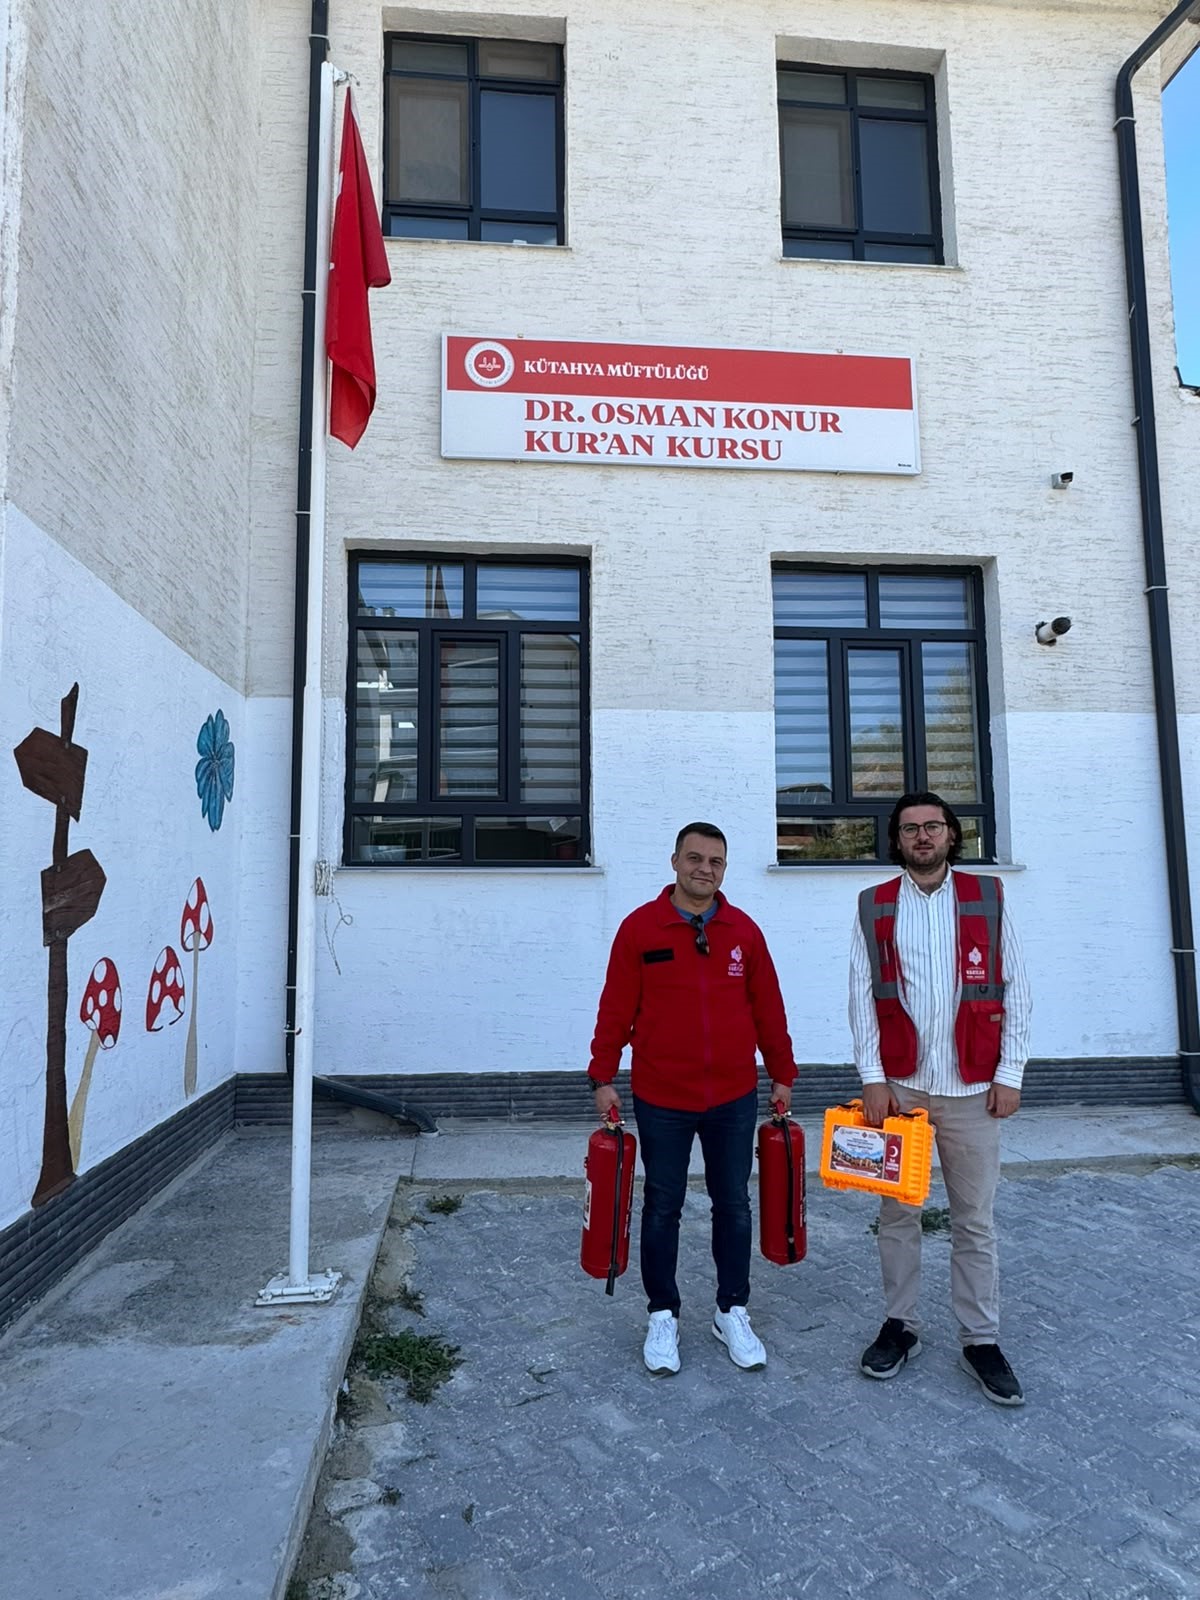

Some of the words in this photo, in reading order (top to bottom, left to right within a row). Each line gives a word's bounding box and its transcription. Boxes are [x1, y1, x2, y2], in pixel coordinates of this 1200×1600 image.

[523, 357, 606, 377] KÜTAHYA
[606, 361, 709, 381] MÜFTÜLÜĞÜ
[524, 399, 585, 423] DR.
[591, 401, 716, 428] OSMAN
[723, 407, 843, 433] KONUR
[667, 435, 783, 461] KURSU
